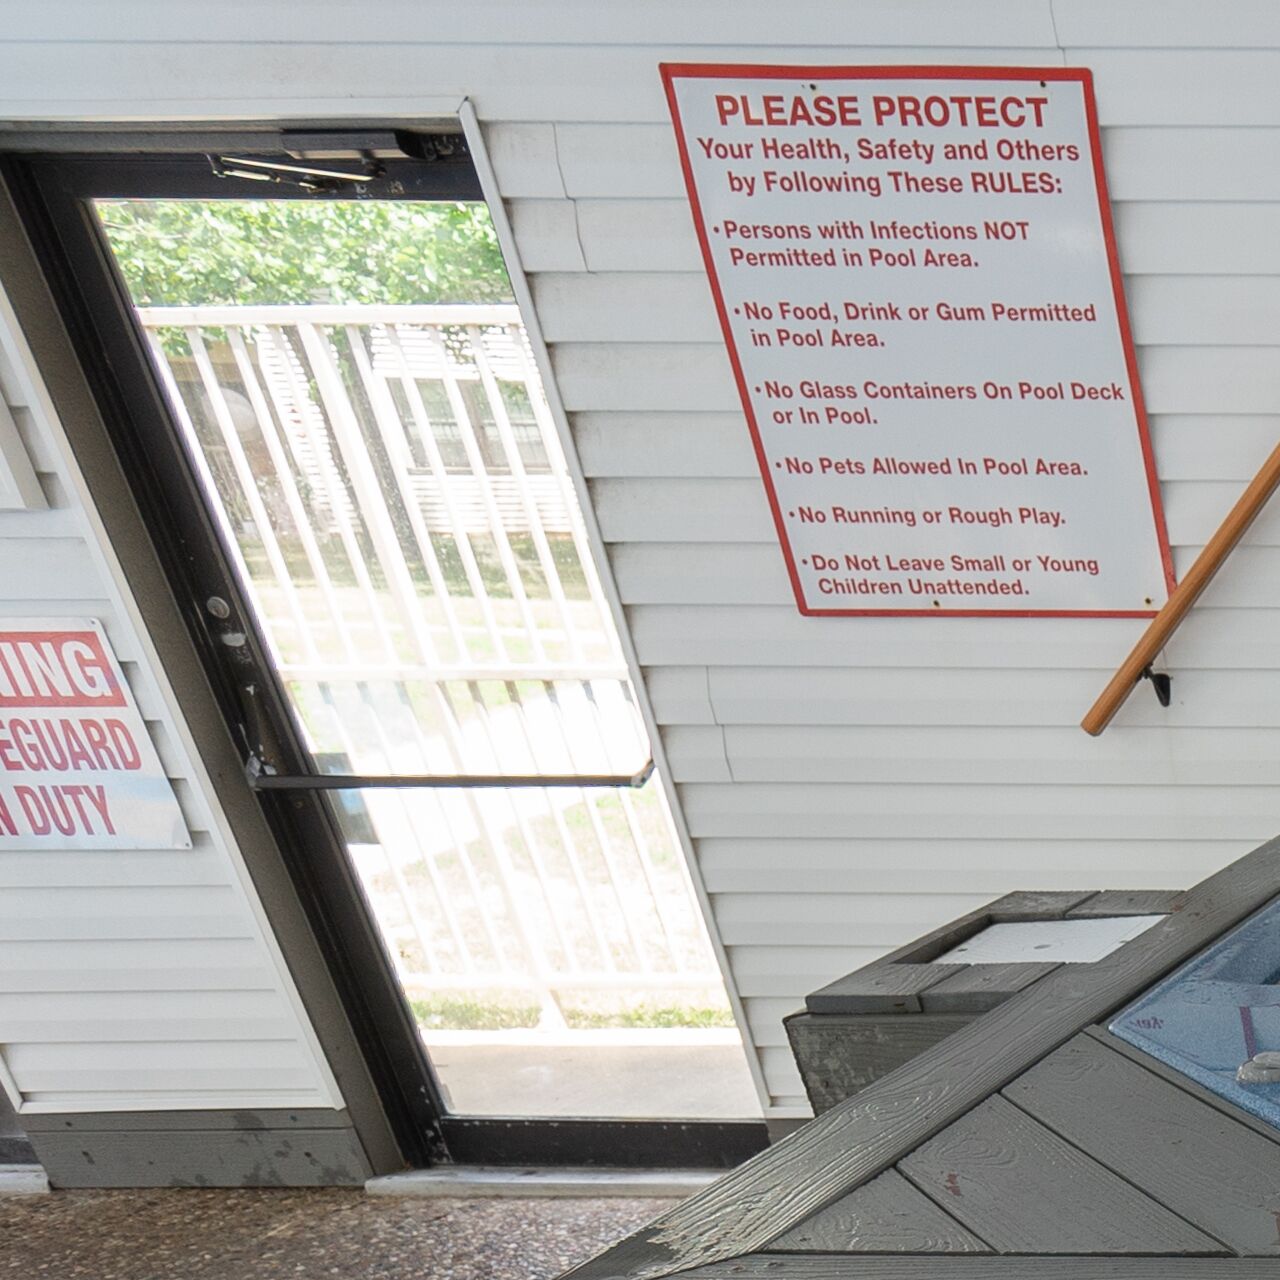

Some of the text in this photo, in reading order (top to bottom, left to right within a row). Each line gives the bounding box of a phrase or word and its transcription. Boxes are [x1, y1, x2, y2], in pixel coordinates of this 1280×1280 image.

[715, 94, 1049, 129] PLEASE PROTECT
[698, 138, 1079, 165] Your Health, Safety and Others
[728, 170, 1063, 197] by Following These RULES:
[724, 220, 1029, 241] Persons with Infections NOT
[730, 246, 978, 267] Permitted in Pool Area.
[744, 301, 1097, 324] No Food, Drink or Gum Permitted
[751, 328, 885, 348] in Pool Area.
[764, 381, 1123, 401] No Glass Containers On Pool Deck
[773, 406, 877, 425] or In Pool.
[784, 457, 1087, 476] No Pets Allowed In Pool Area.
[799, 506, 1066, 528] No Running or Rough Play.
[810, 554, 1101, 576] Do Not Leave Small or Young
[818, 577, 1029, 595] Children Unattended.
[13, 785, 116, 836] DUTY
